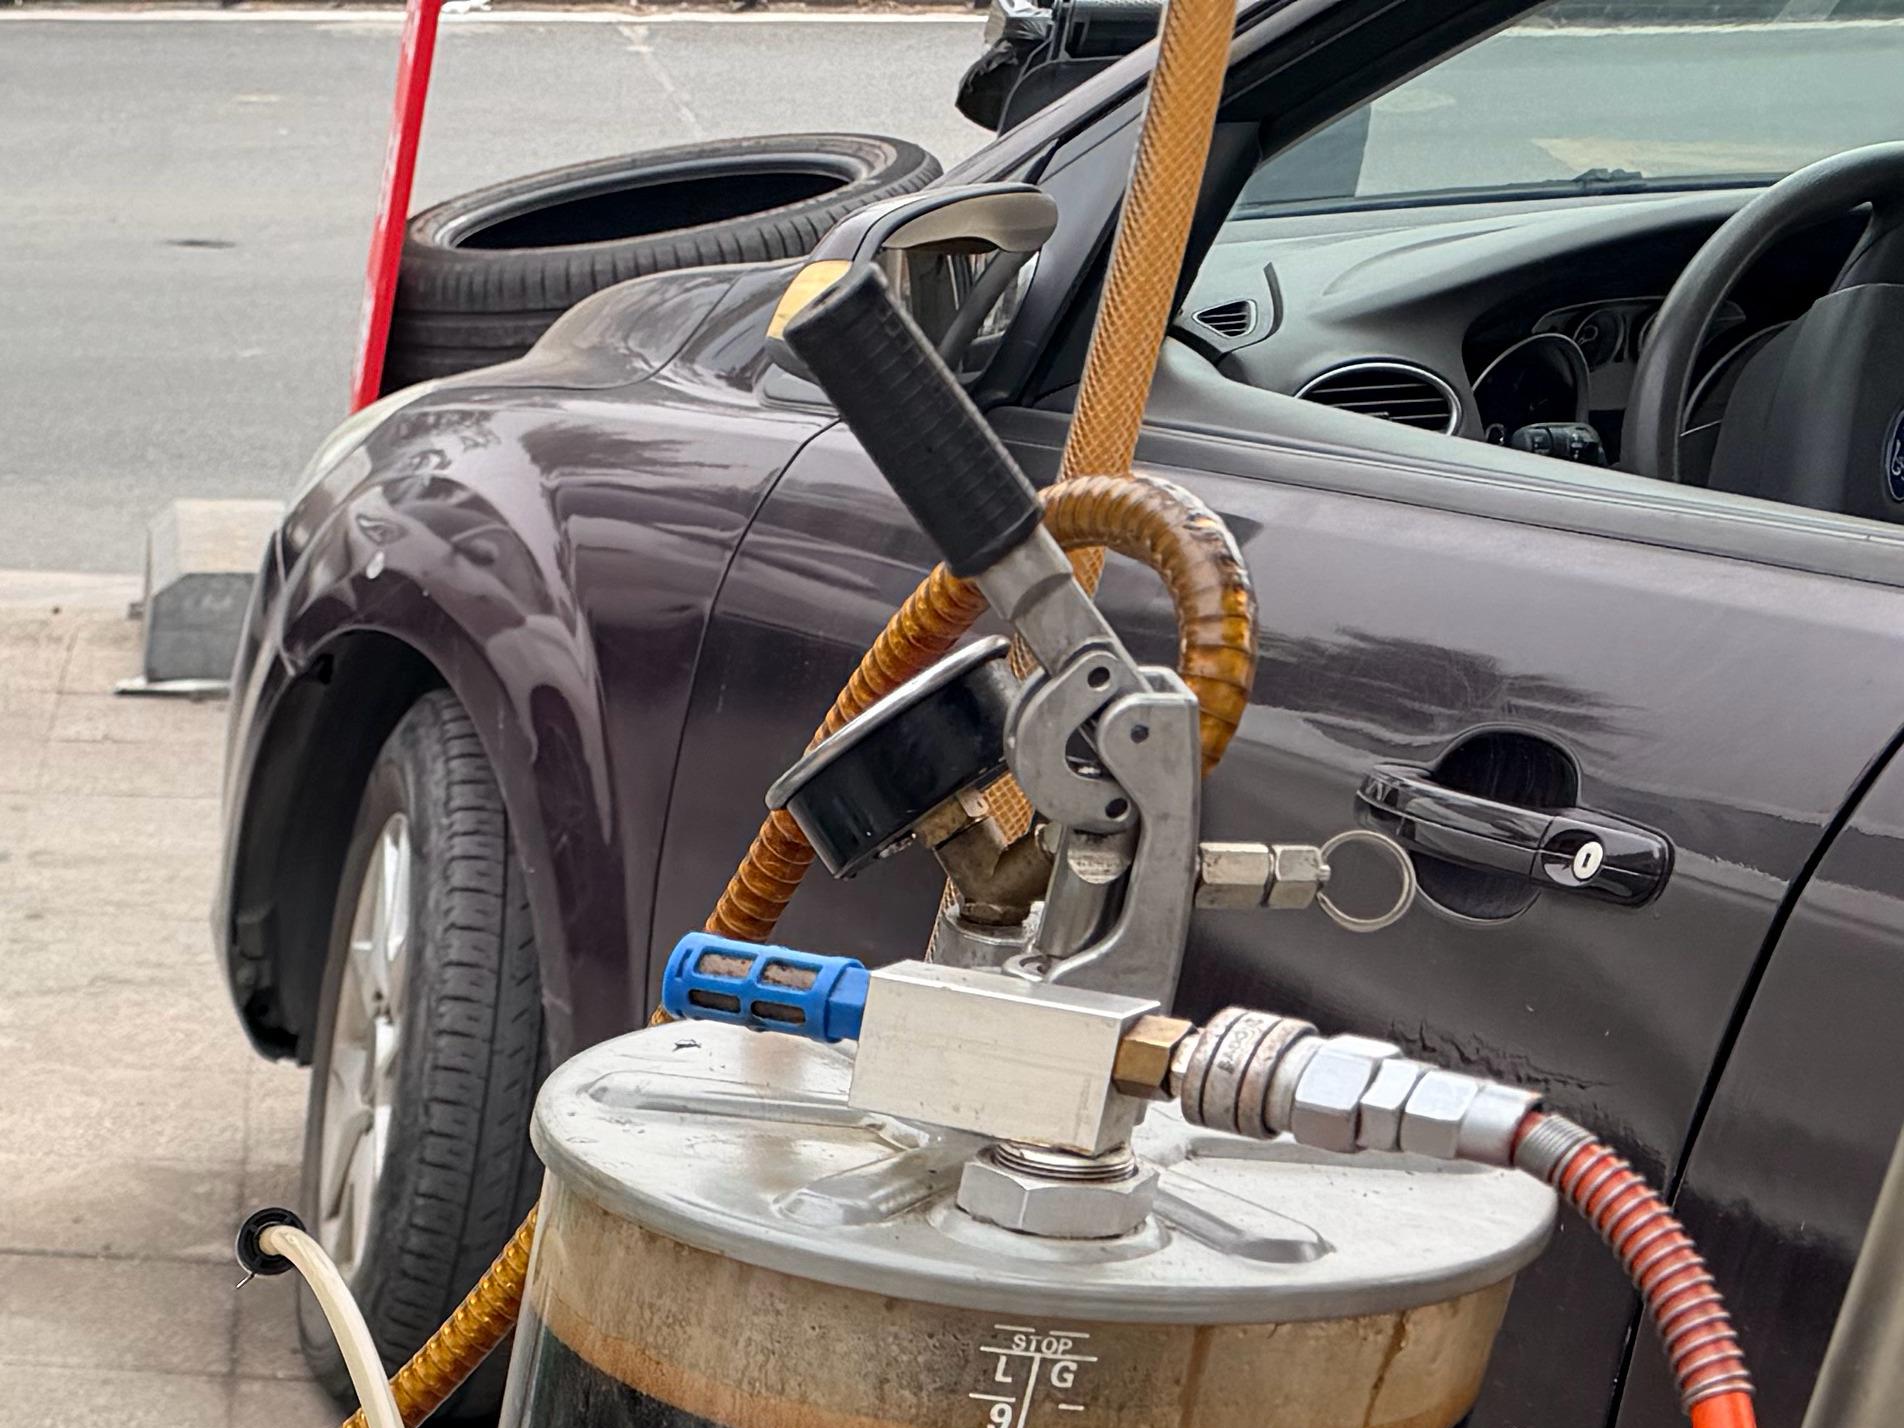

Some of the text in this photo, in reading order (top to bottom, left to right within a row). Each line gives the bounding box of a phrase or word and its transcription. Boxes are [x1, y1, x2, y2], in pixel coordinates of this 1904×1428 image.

[1011, 1334, 1073, 1356] STOP
[994, 1355, 1077, 1389] L G
